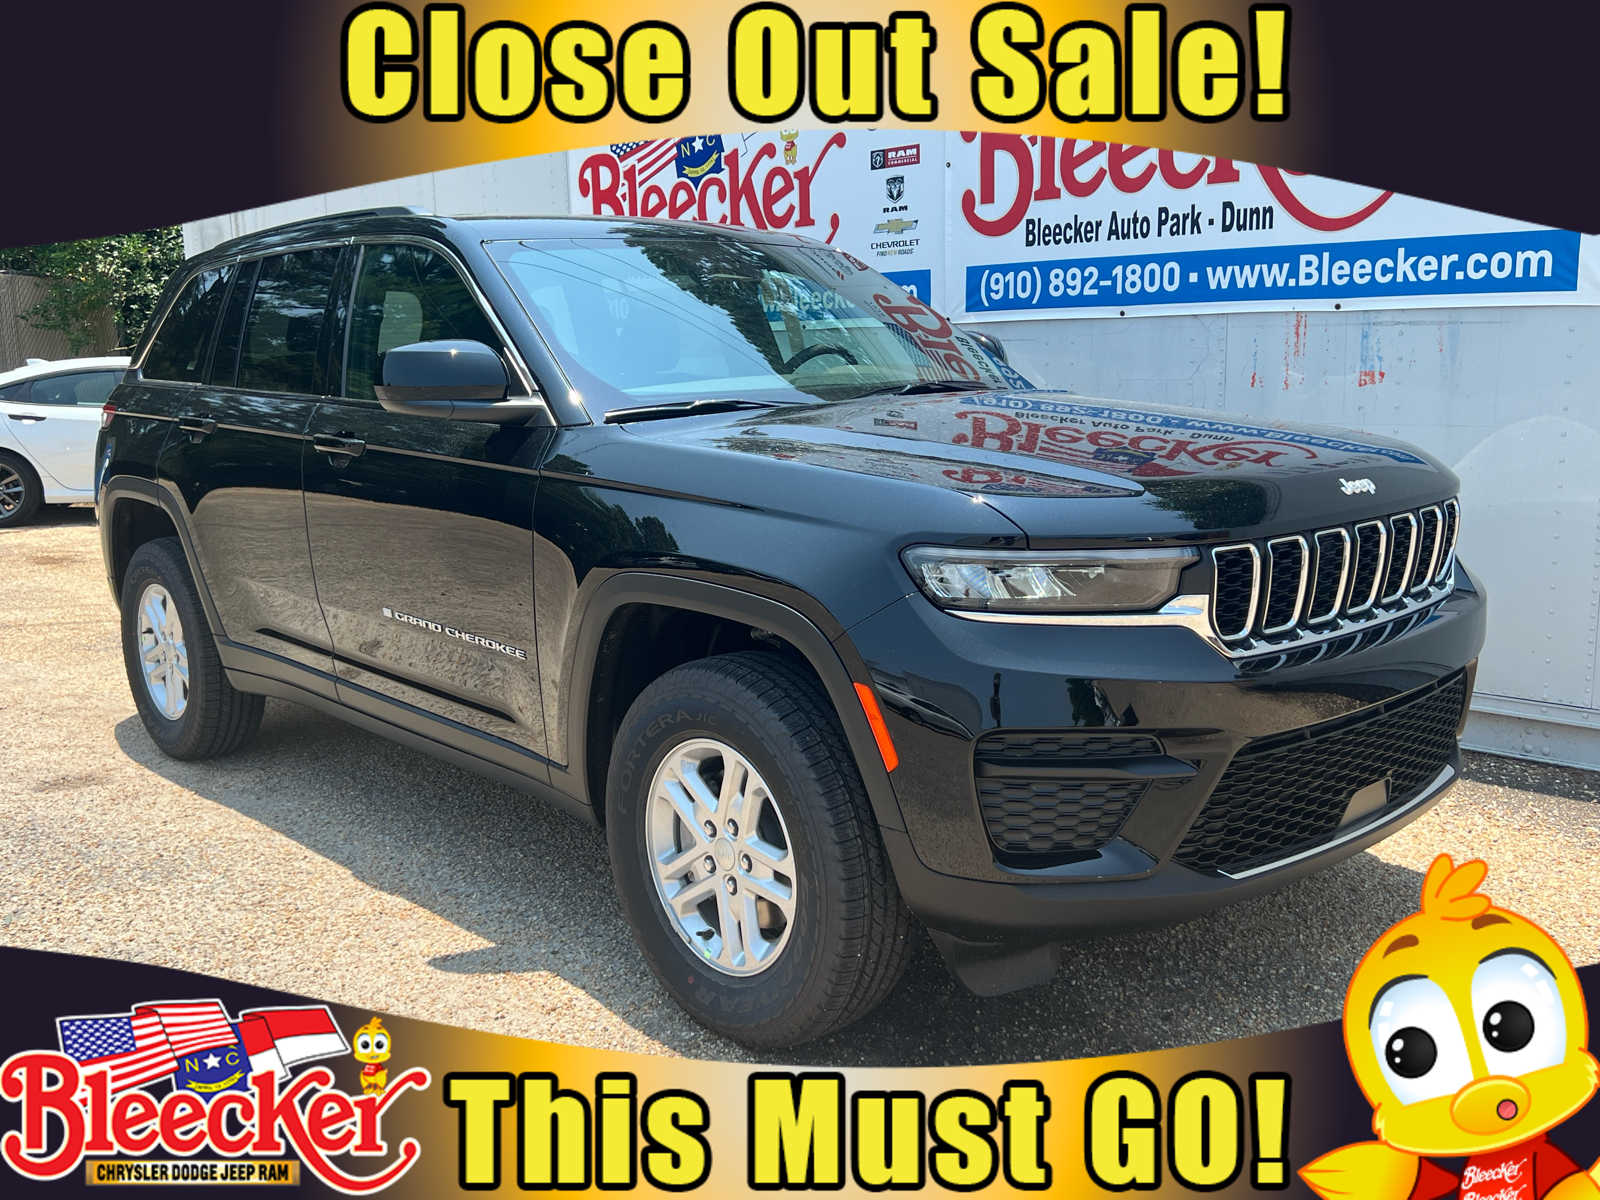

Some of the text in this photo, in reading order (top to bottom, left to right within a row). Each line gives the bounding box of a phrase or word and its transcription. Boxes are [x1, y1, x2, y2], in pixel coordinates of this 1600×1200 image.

[887, 148, 917, 159] RAM
[883, 205, 908, 214] RAM
[1024, 200, 1274, 247] Bleecker Auto Park Dunn
[870, 239, 921, 250] CHEVROLET
[980, 244, 1554, 308] (910) 892-1800 www.Bleecker.com
[1338, 478, 1376, 496] Jeep
[395, 611, 527, 661] GRAND CHEROKEE
